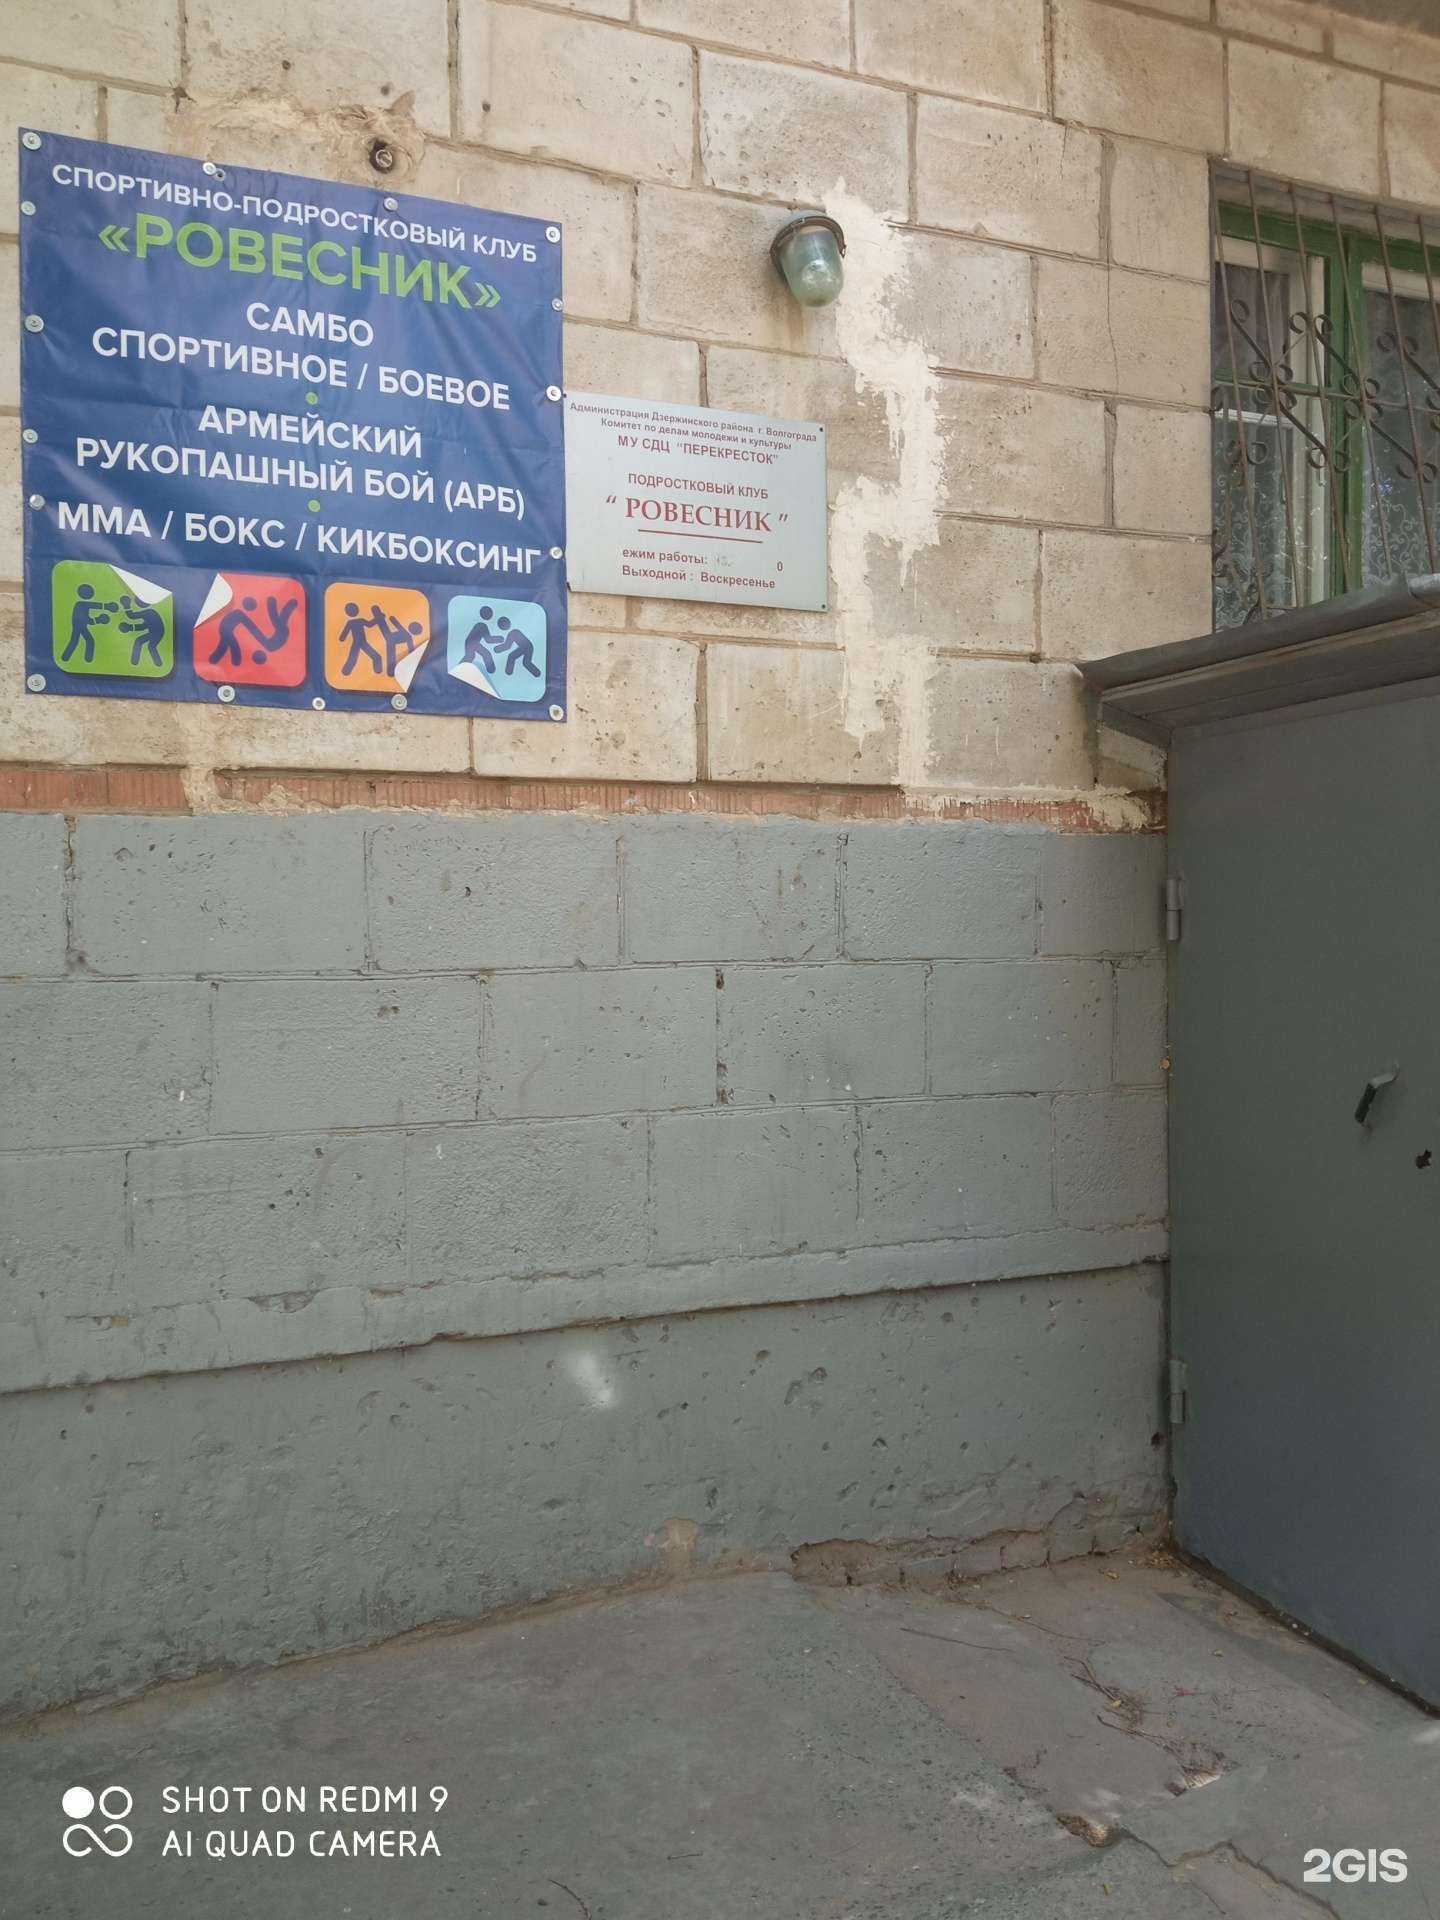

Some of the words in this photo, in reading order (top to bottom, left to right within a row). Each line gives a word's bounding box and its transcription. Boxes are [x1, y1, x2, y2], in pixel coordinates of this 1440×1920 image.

[52, 163, 466, 252] СПОРТИВНО-ПОДРОСТКОВЫЙ
[472, 237, 537, 263] КЛУБ
[98, 213, 502, 309] «РОВЕСНИК»
[246, 301, 375, 348] САМБО
[92, 326, 348, 387] СПОРТИВНОЕ
[378, 366, 511, 411] БОЕВОЕ
[198, 404, 423, 458] АРМЕЙСКИЙ
[570, 402, 650, 419] Администрация
[651, 411, 719, 428] Дзержинского
[720, 422, 754, 434] района
[766, 427, 817, 442] Волгограда
[601, 417, 641, 431] Комитет
[644, 424, 657, 433] по
[658, 426, 689, 437] делам
[691, 430, 739, 443] молодежи
[749, 437, 792, 451] культуры
[618, 434, 639, 448] МУ
[642, 437, 671, 454] СДЦ
[76, 437, 354, 493] РУКОПАШНЫЙ
[364, 468, 435, 504] БОЙ
[444, 479, 526, 520] (АРБ)
[628, 473, 735, 495] ПОДРОСТКОВЫЙ
[738, 486, 769, 499] КЛУБ
[58, 502, 152, 538] ММА
[184, 516, 287, 549] БОКС
[317, 525, 542, 575] КИКБОКСИНГ
[622, 565, 687, 581] Выходной
[700, 571, 776, 588] Воскресенье
